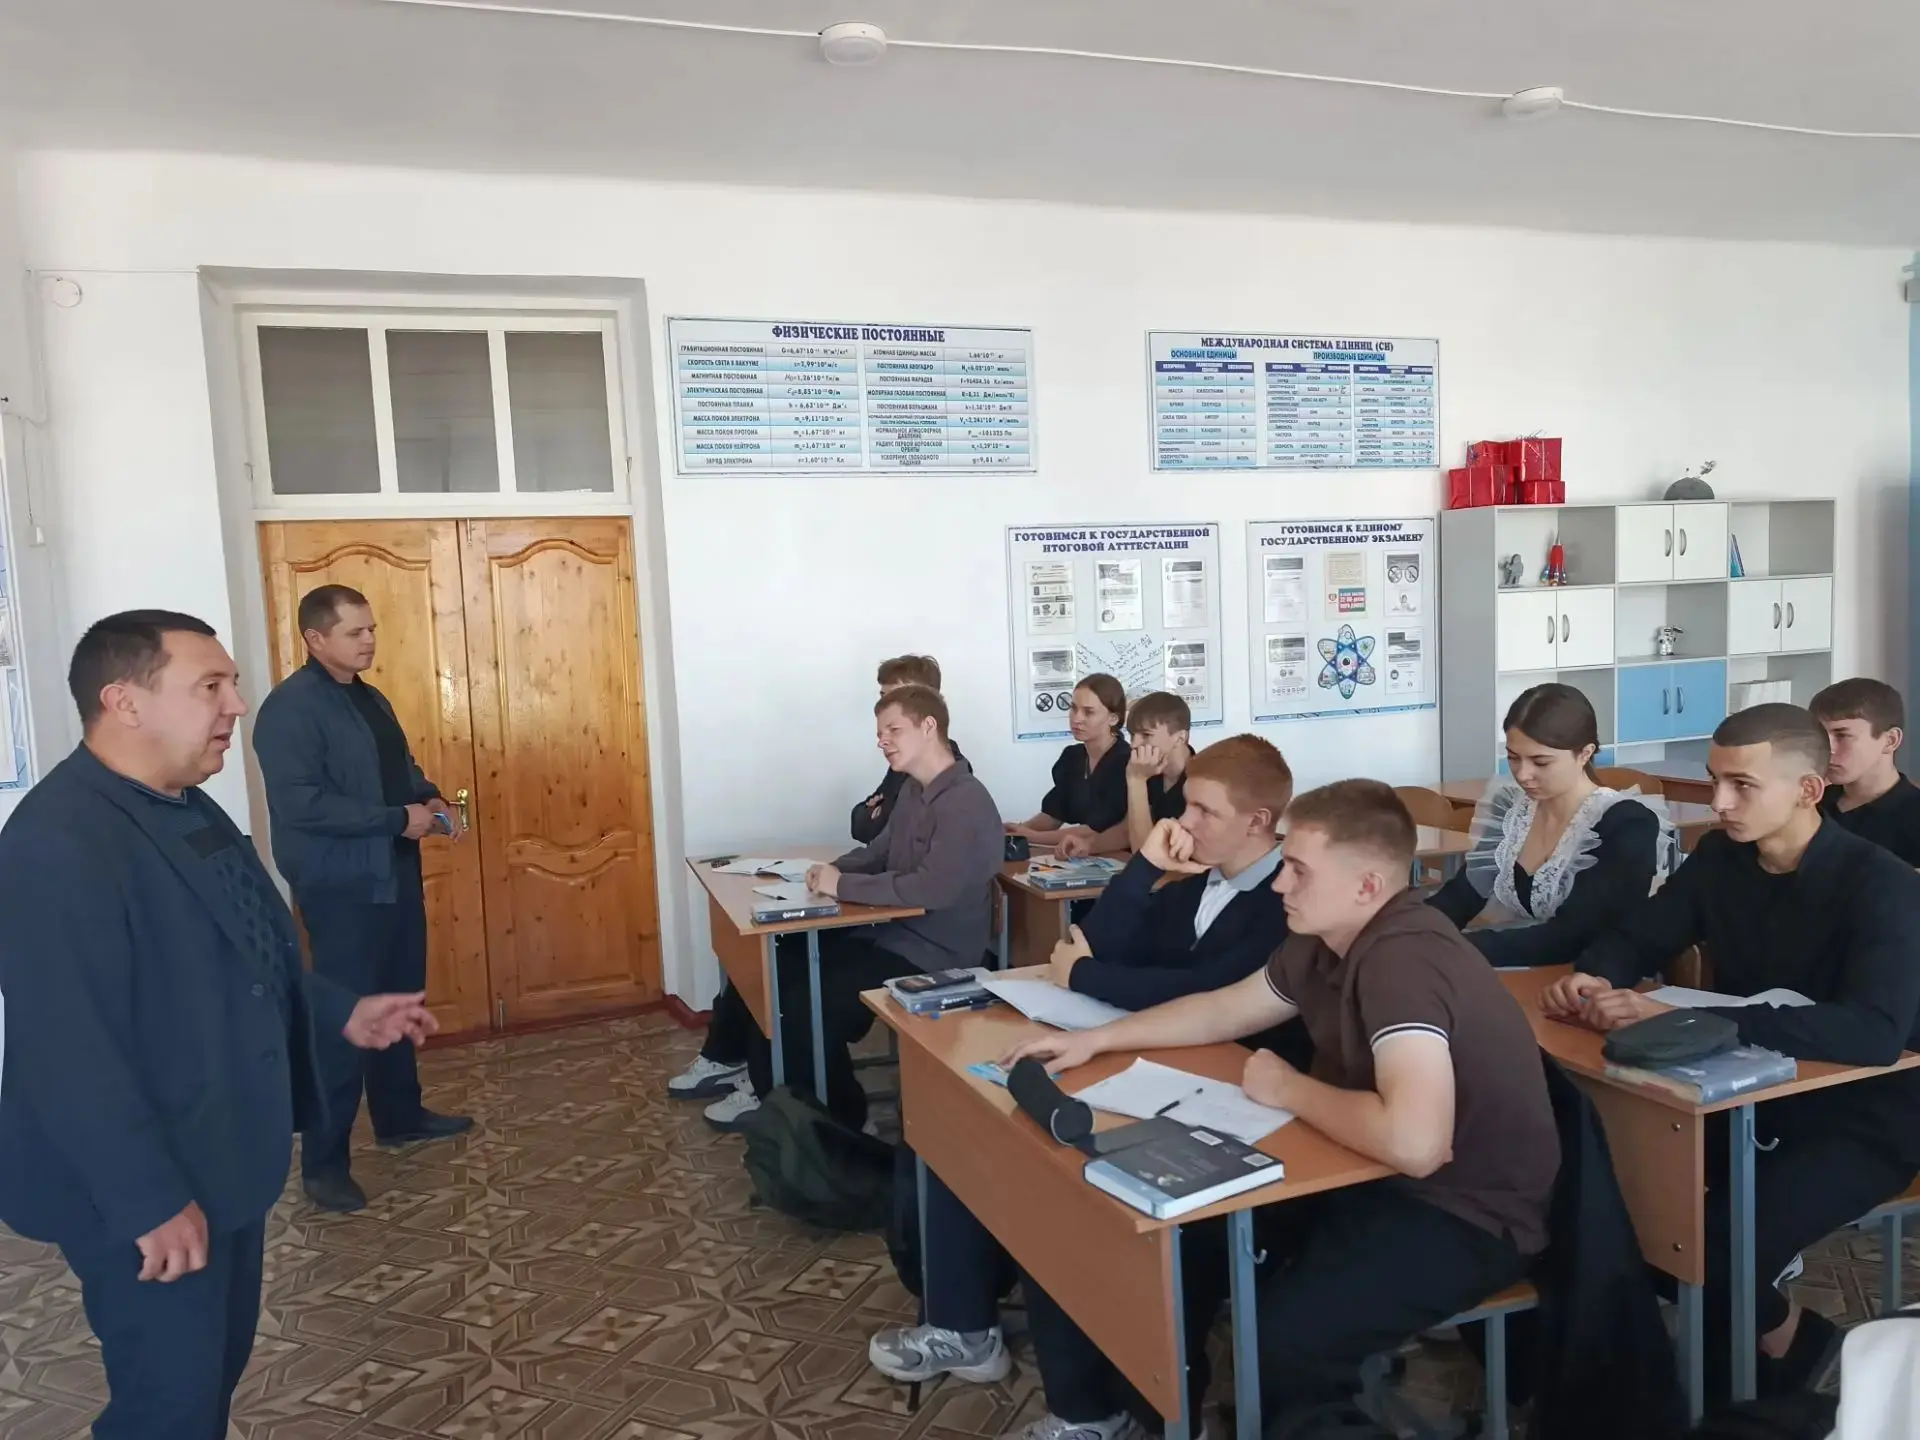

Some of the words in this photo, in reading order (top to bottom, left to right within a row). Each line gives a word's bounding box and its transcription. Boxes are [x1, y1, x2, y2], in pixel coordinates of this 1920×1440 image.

[772, 325, 859, 340] ФИЗИЧЕСКИЕ
[862, 328, 945, 342] ПОСТОЯННЫЕ
[1201, 338, 1289, 348] МЕЖДУНАРОДНАЯ
[1292, 340, 1333, 349] СИСТЕМА
[1336, 340, 1373, 351] ЕДИНИЦ
[1375, 342, 1393, 352] (СИ)
[1207, 351, 1237, 359] ЕДИНИЦЫ
[1313, 352, 1357, 360] ПРОИЗВОДНЫЕ
[1358, 353, 1385, 361] ЕДИНИЦЫ
[1015, 531, 1086, 541] ГОТОВИМСЯ
[1090, 531, 1098, 540] К
[1100, 527, 1210, 540] ГОСУДАРСТВЕННОЙ
[1281, 525, 1343, 534] ГОТОВИМСЯ
[1345, 525, 1353, 533] К
[1356, 523, 1403, 532] ЕДИНОМУ
[1261, 535, 1368, 546] ГОСУДАРСТВЕННОМУ
[1371, 533, 1424, 543] ЭКЗАМЕНУ
[1043, 541, 1105, 553] ИТОГОВОЙ
